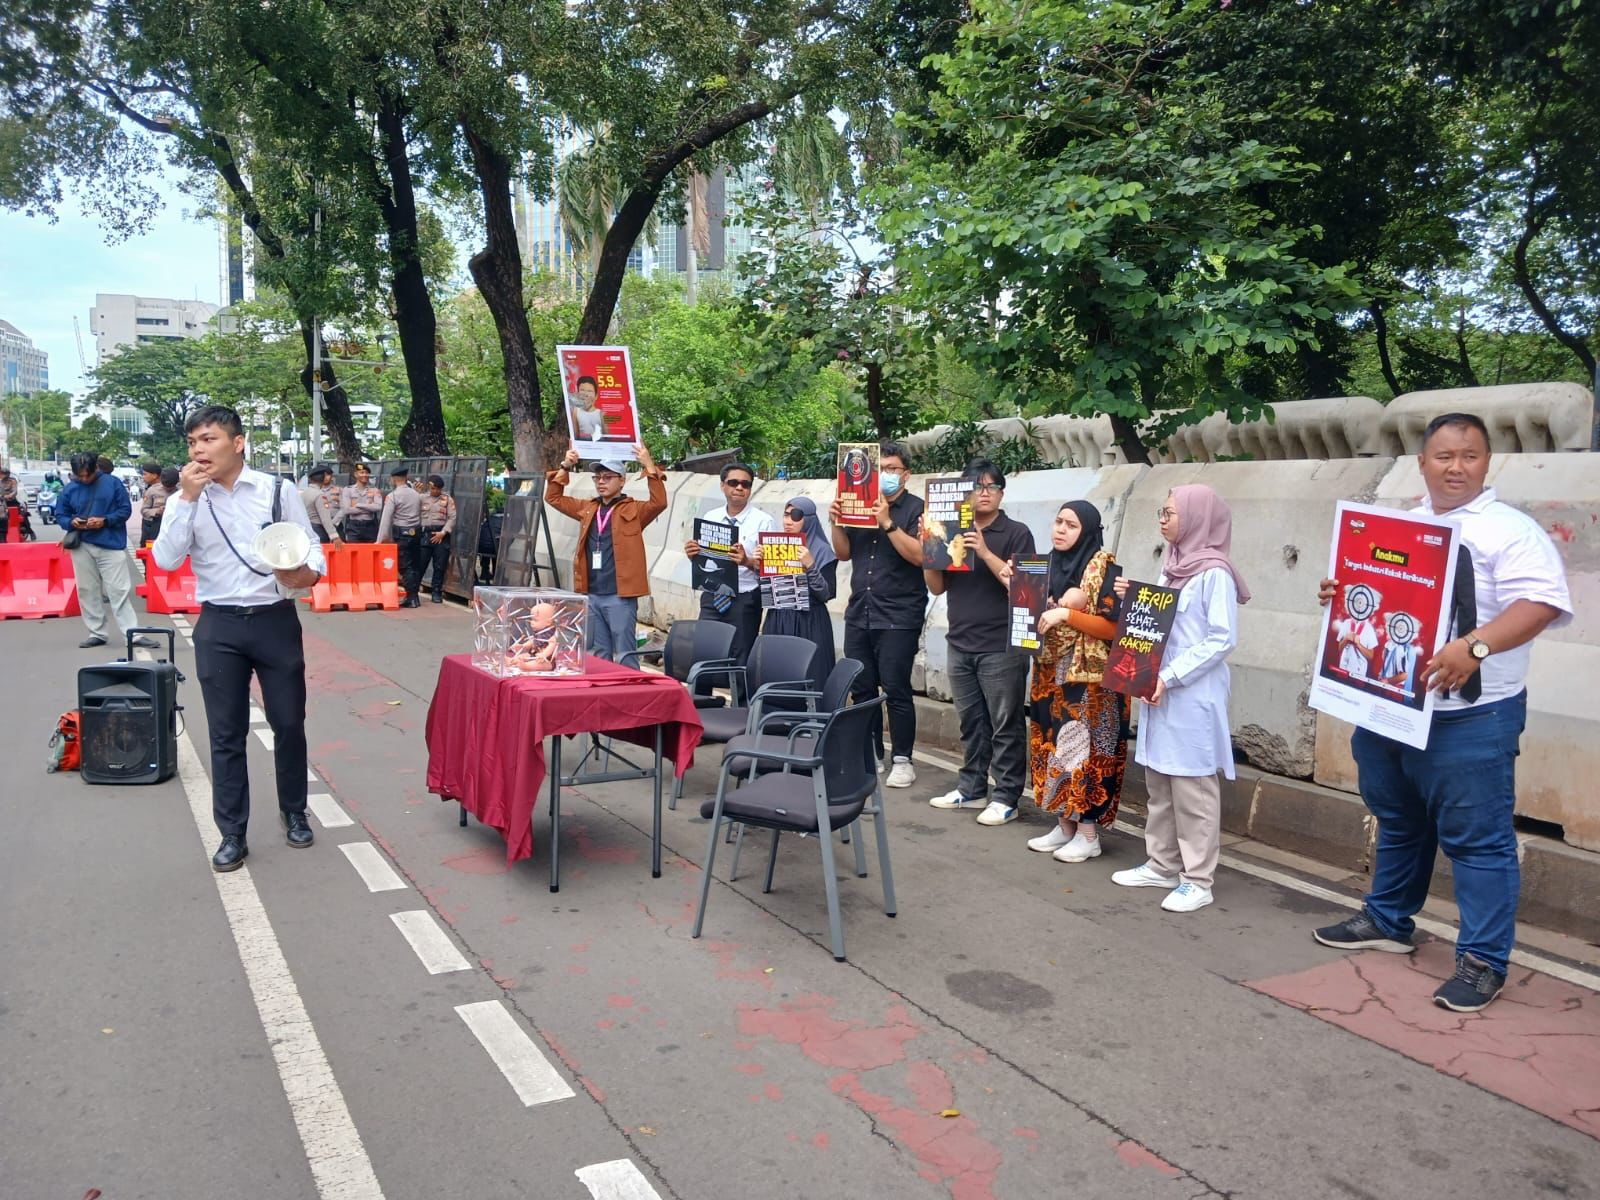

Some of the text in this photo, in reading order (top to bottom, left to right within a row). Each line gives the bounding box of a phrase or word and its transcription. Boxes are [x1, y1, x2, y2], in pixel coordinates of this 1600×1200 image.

[941, 482, 957, 492] JUTA
[957, 481, 974, 491] ANAK
[928, 492, 964, 502] INDONESIA
[928, 502, 955, 511] ADALAH
[928, 511, 959, 521] PEROKOK
[762, 536, 802, 545] MEREKA JUGA
[1375, 548, 1405, 564] Anakmu
[1344, 558, 1435, 588] Target Industri Rokok Berikutnya
[1137, 587, 1173, 612] #RIP
[1131, 601, 1151, 614] HAK
[1125, 611, 1159, 628] SEHAT-
[1118, 637, 1153, 654] RAKYAT
